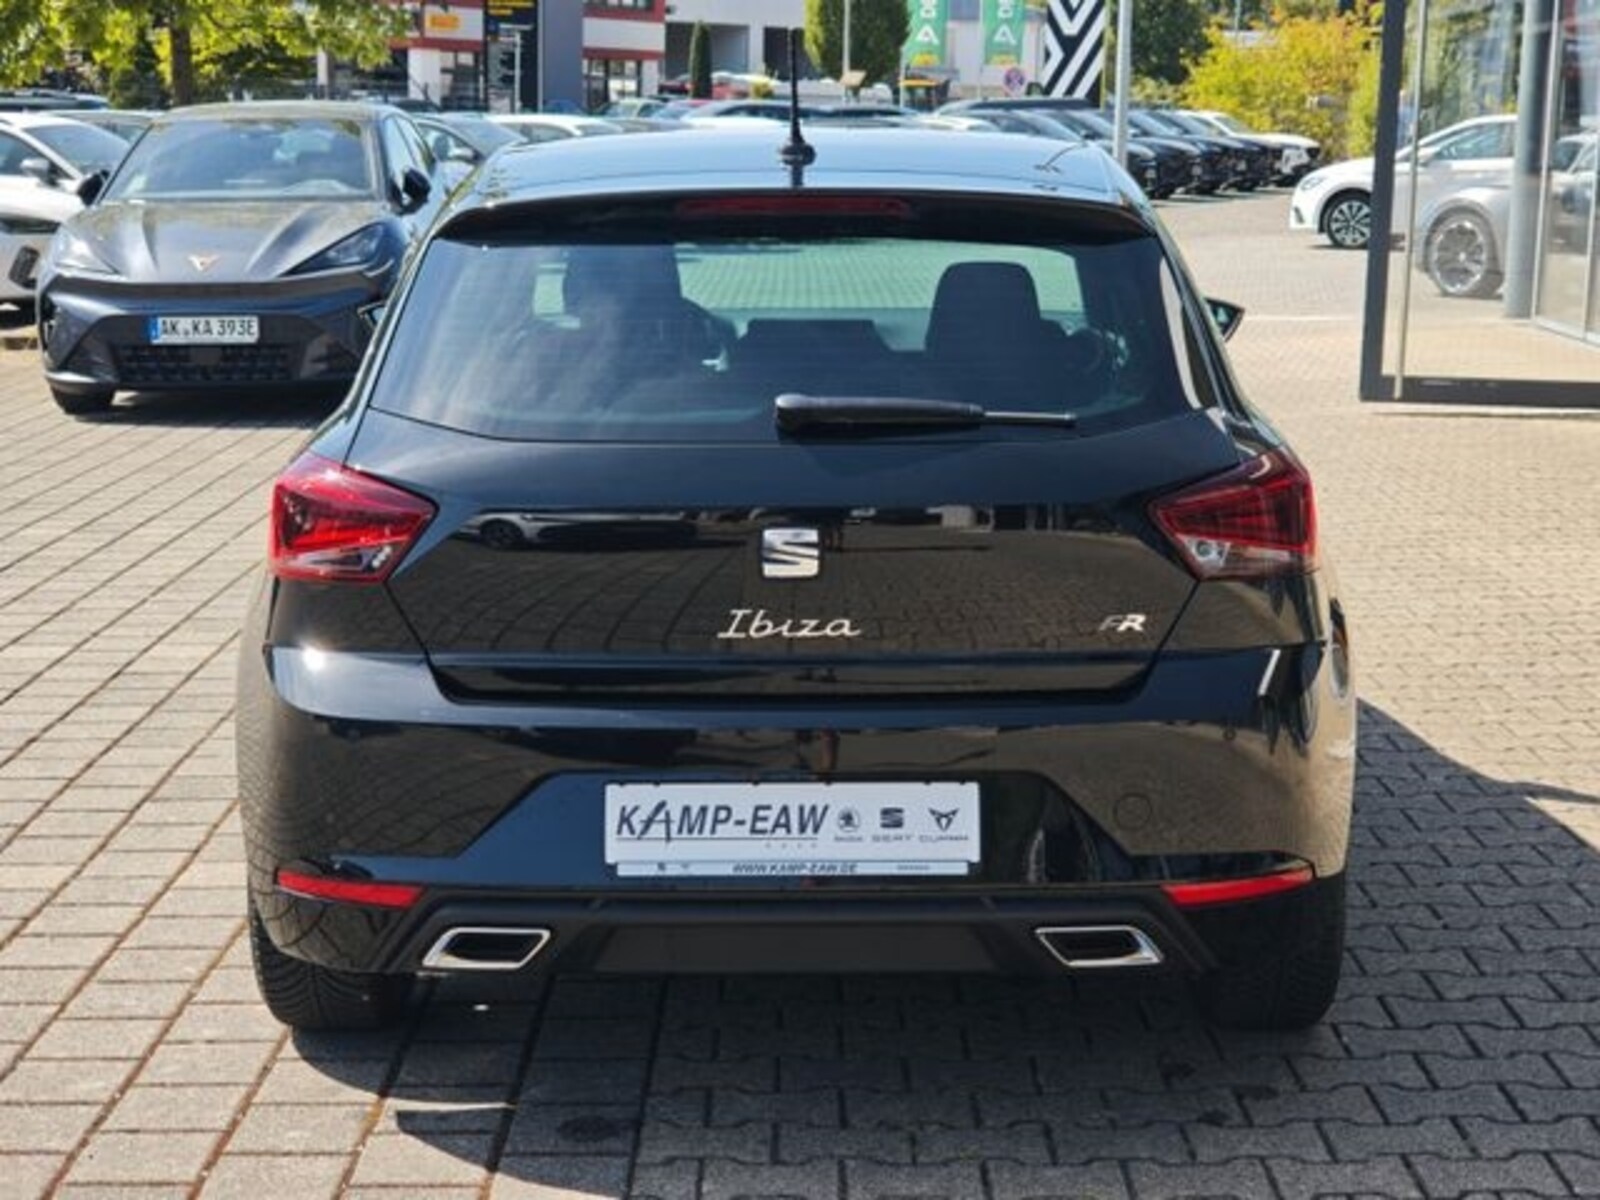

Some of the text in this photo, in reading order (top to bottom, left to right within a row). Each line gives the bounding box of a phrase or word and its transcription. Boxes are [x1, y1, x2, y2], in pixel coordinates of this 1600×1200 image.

[161, 319, 255, 336] AK KA 393E
[716, 608, 862, 639] Ibiza
[1099, 613, 1147, 632] FR
[616, 800, 829, 843] KAMP-EAW
